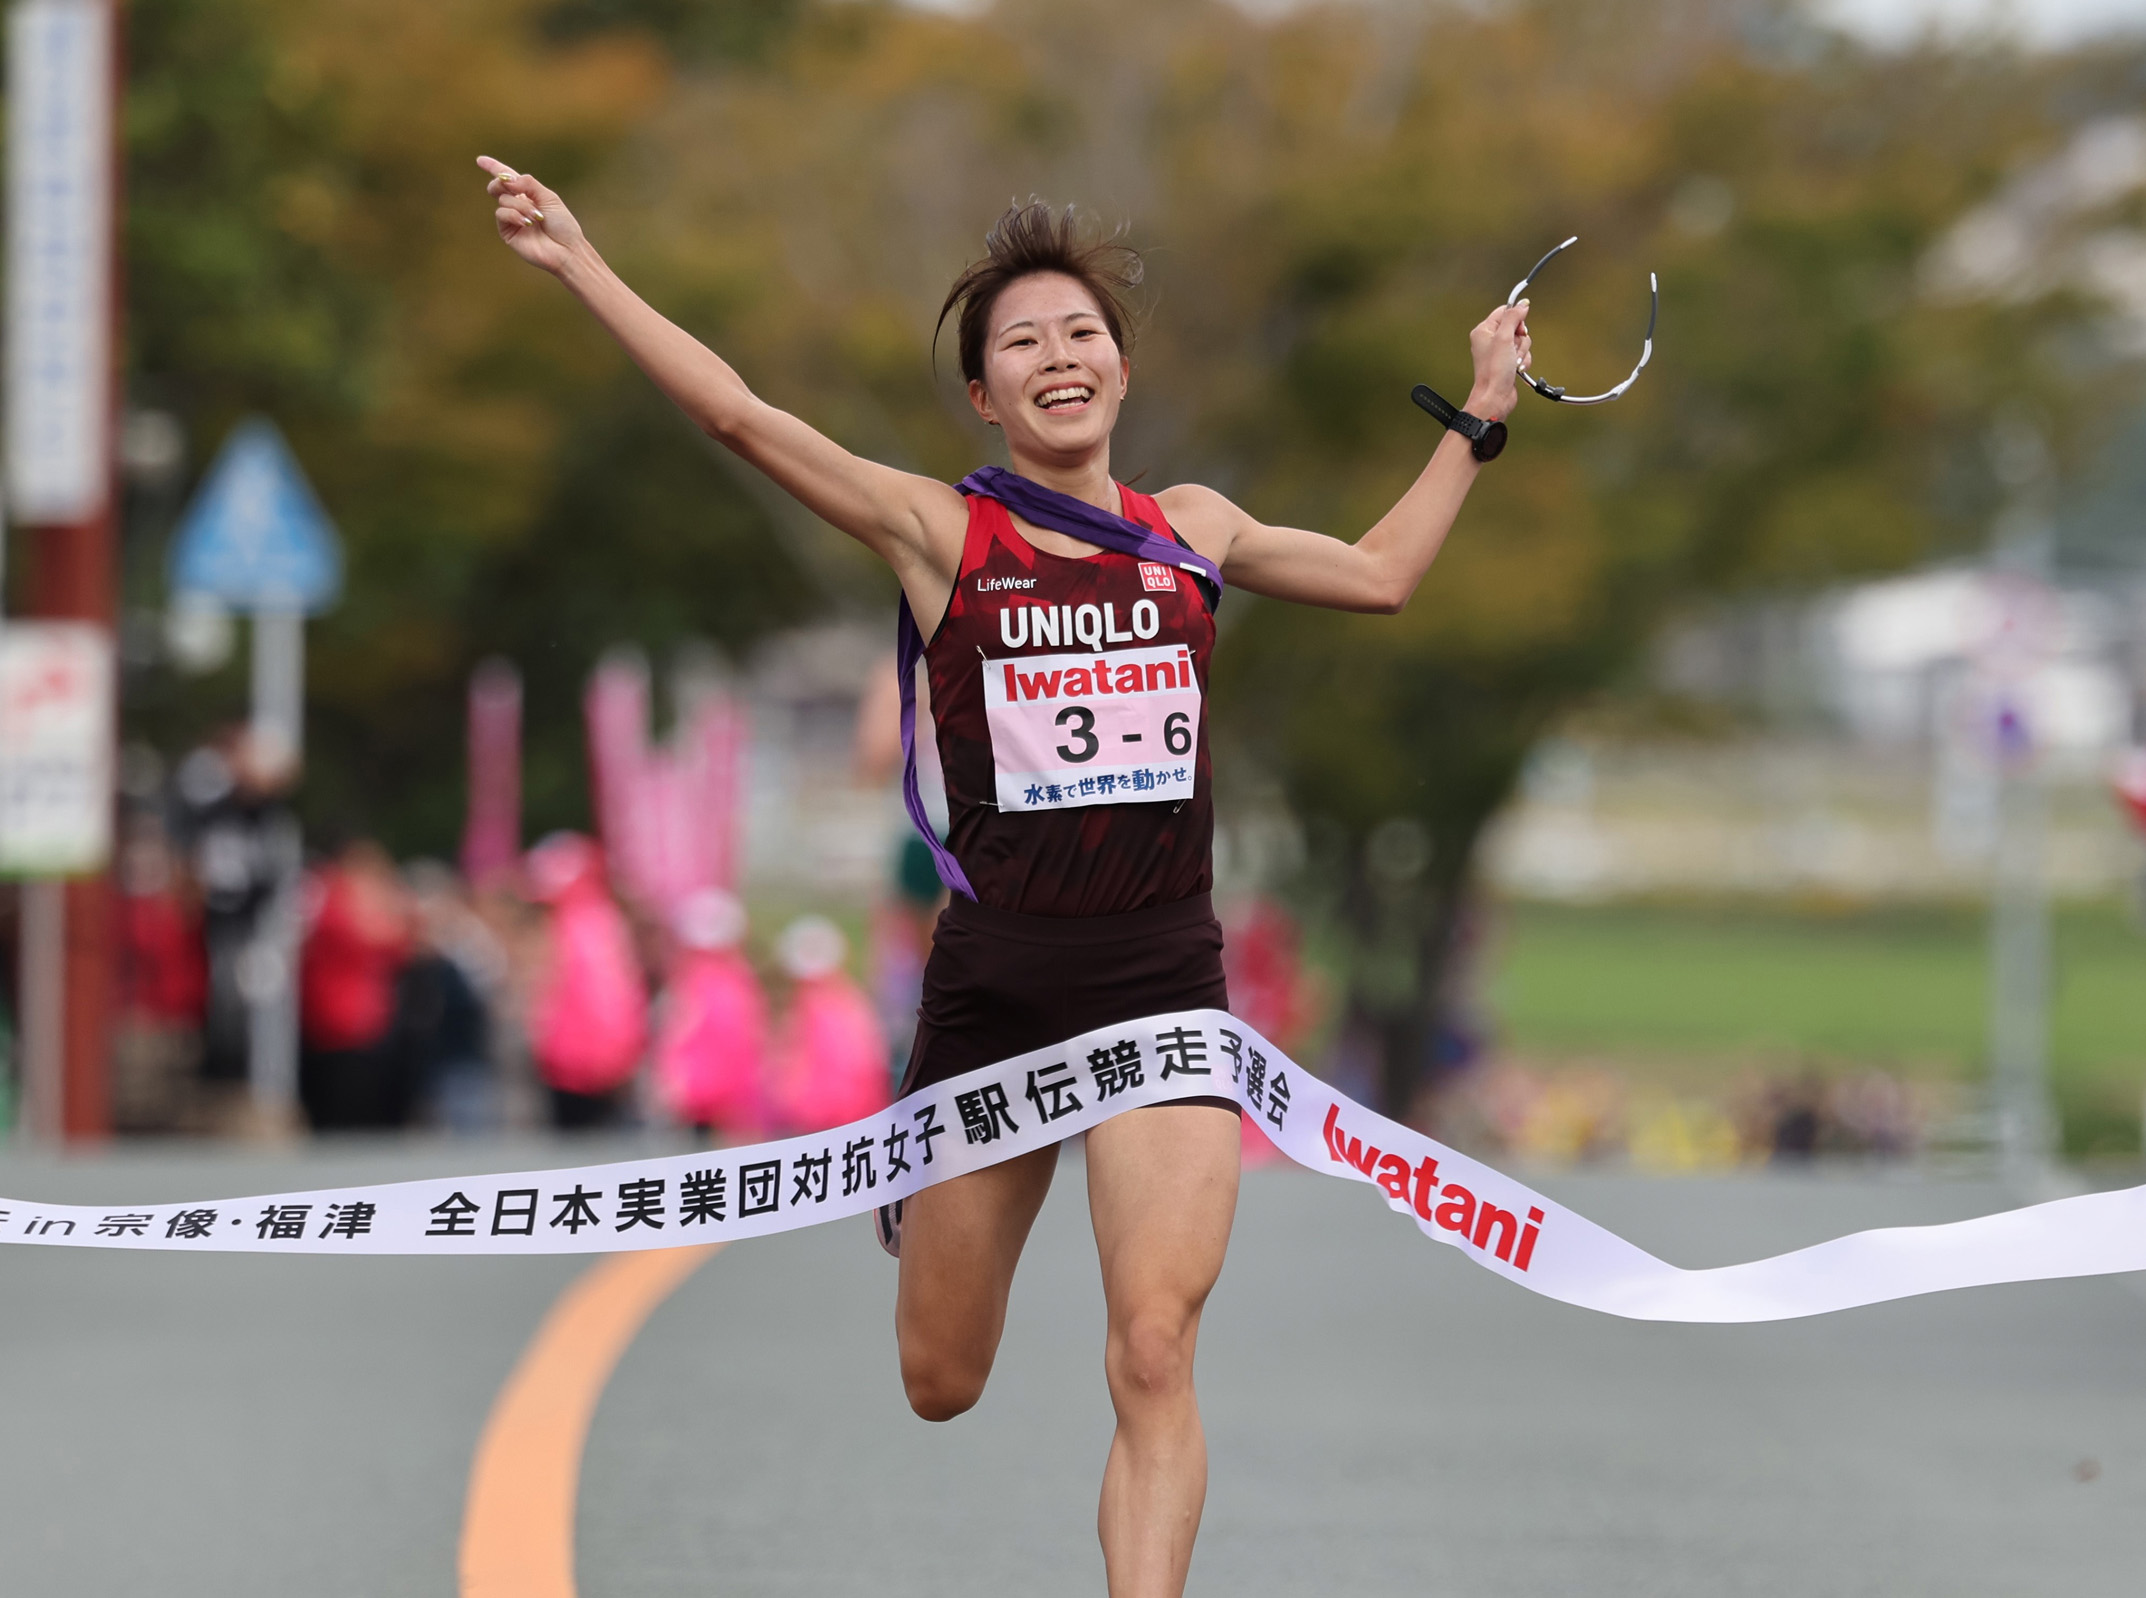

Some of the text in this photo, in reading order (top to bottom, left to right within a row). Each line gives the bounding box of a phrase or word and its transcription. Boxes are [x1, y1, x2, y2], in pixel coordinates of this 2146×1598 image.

[977, 577, 1037, 591] LifeWear
[1144, 566, 1166, 576] UNI
[1147, 577, 1171, 588] QLO
[1000, 599, 1160, 651] UNIQLO
[1003, 650, 1191, 702] Iwatani
[1024, 768, 1193, 805] 水素で世界を動かせ。
[1322, 1103, 1544, 1272] Iwatani
[23, 1216, 77, 1236] in
